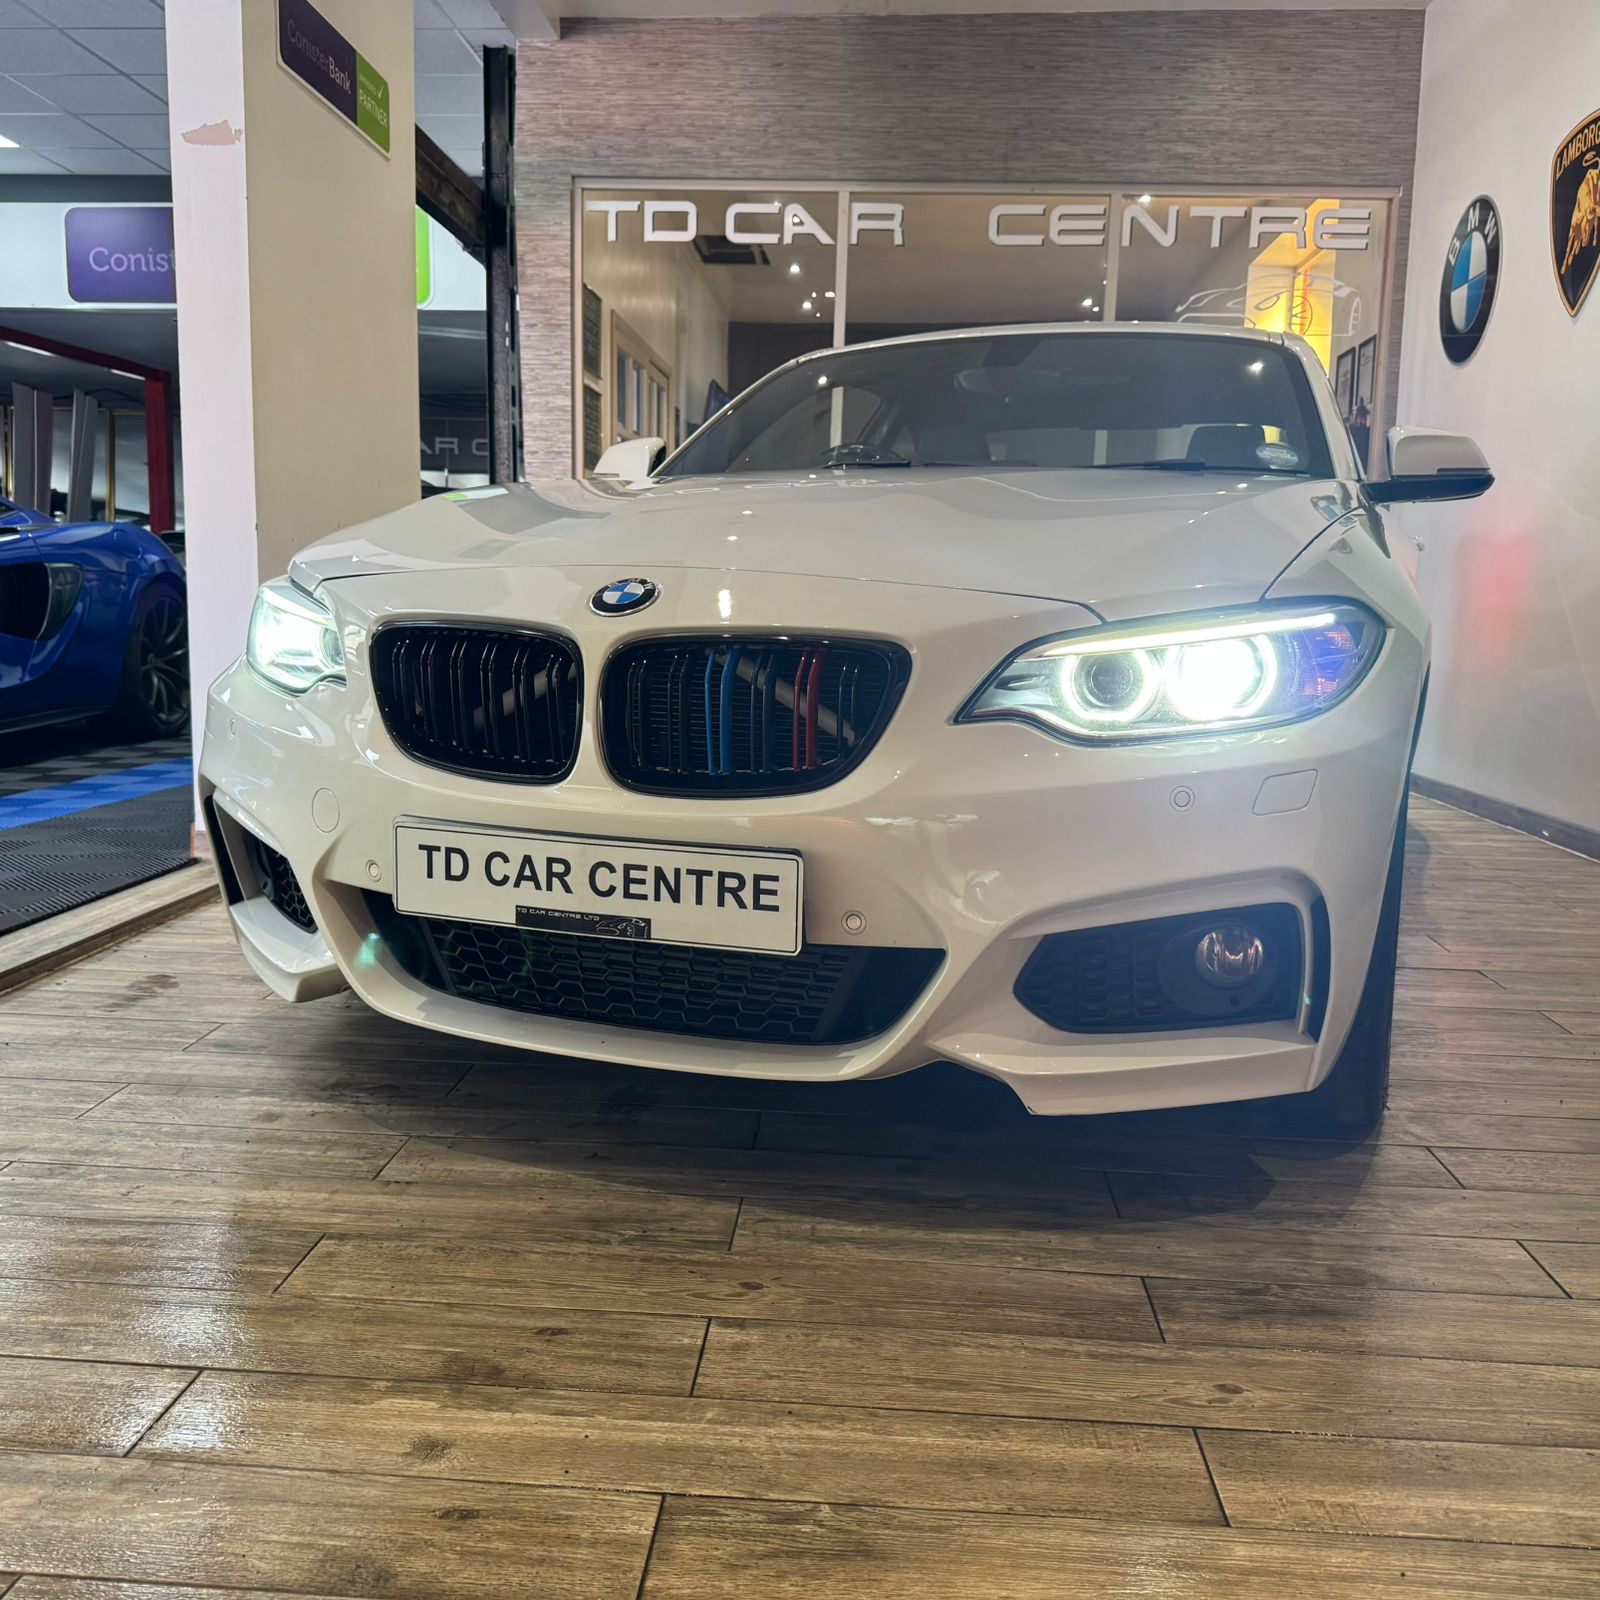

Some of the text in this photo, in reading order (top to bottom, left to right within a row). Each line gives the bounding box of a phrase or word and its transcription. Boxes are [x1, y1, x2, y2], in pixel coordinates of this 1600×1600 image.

[586, 200, 1372, 250] TD CAR CENTRE
[1449, 202, 1497, 267] BMW
[418, 844, 780, 912] TD CAR CENTRE
[548, 911, 581, 919] CENTRE
